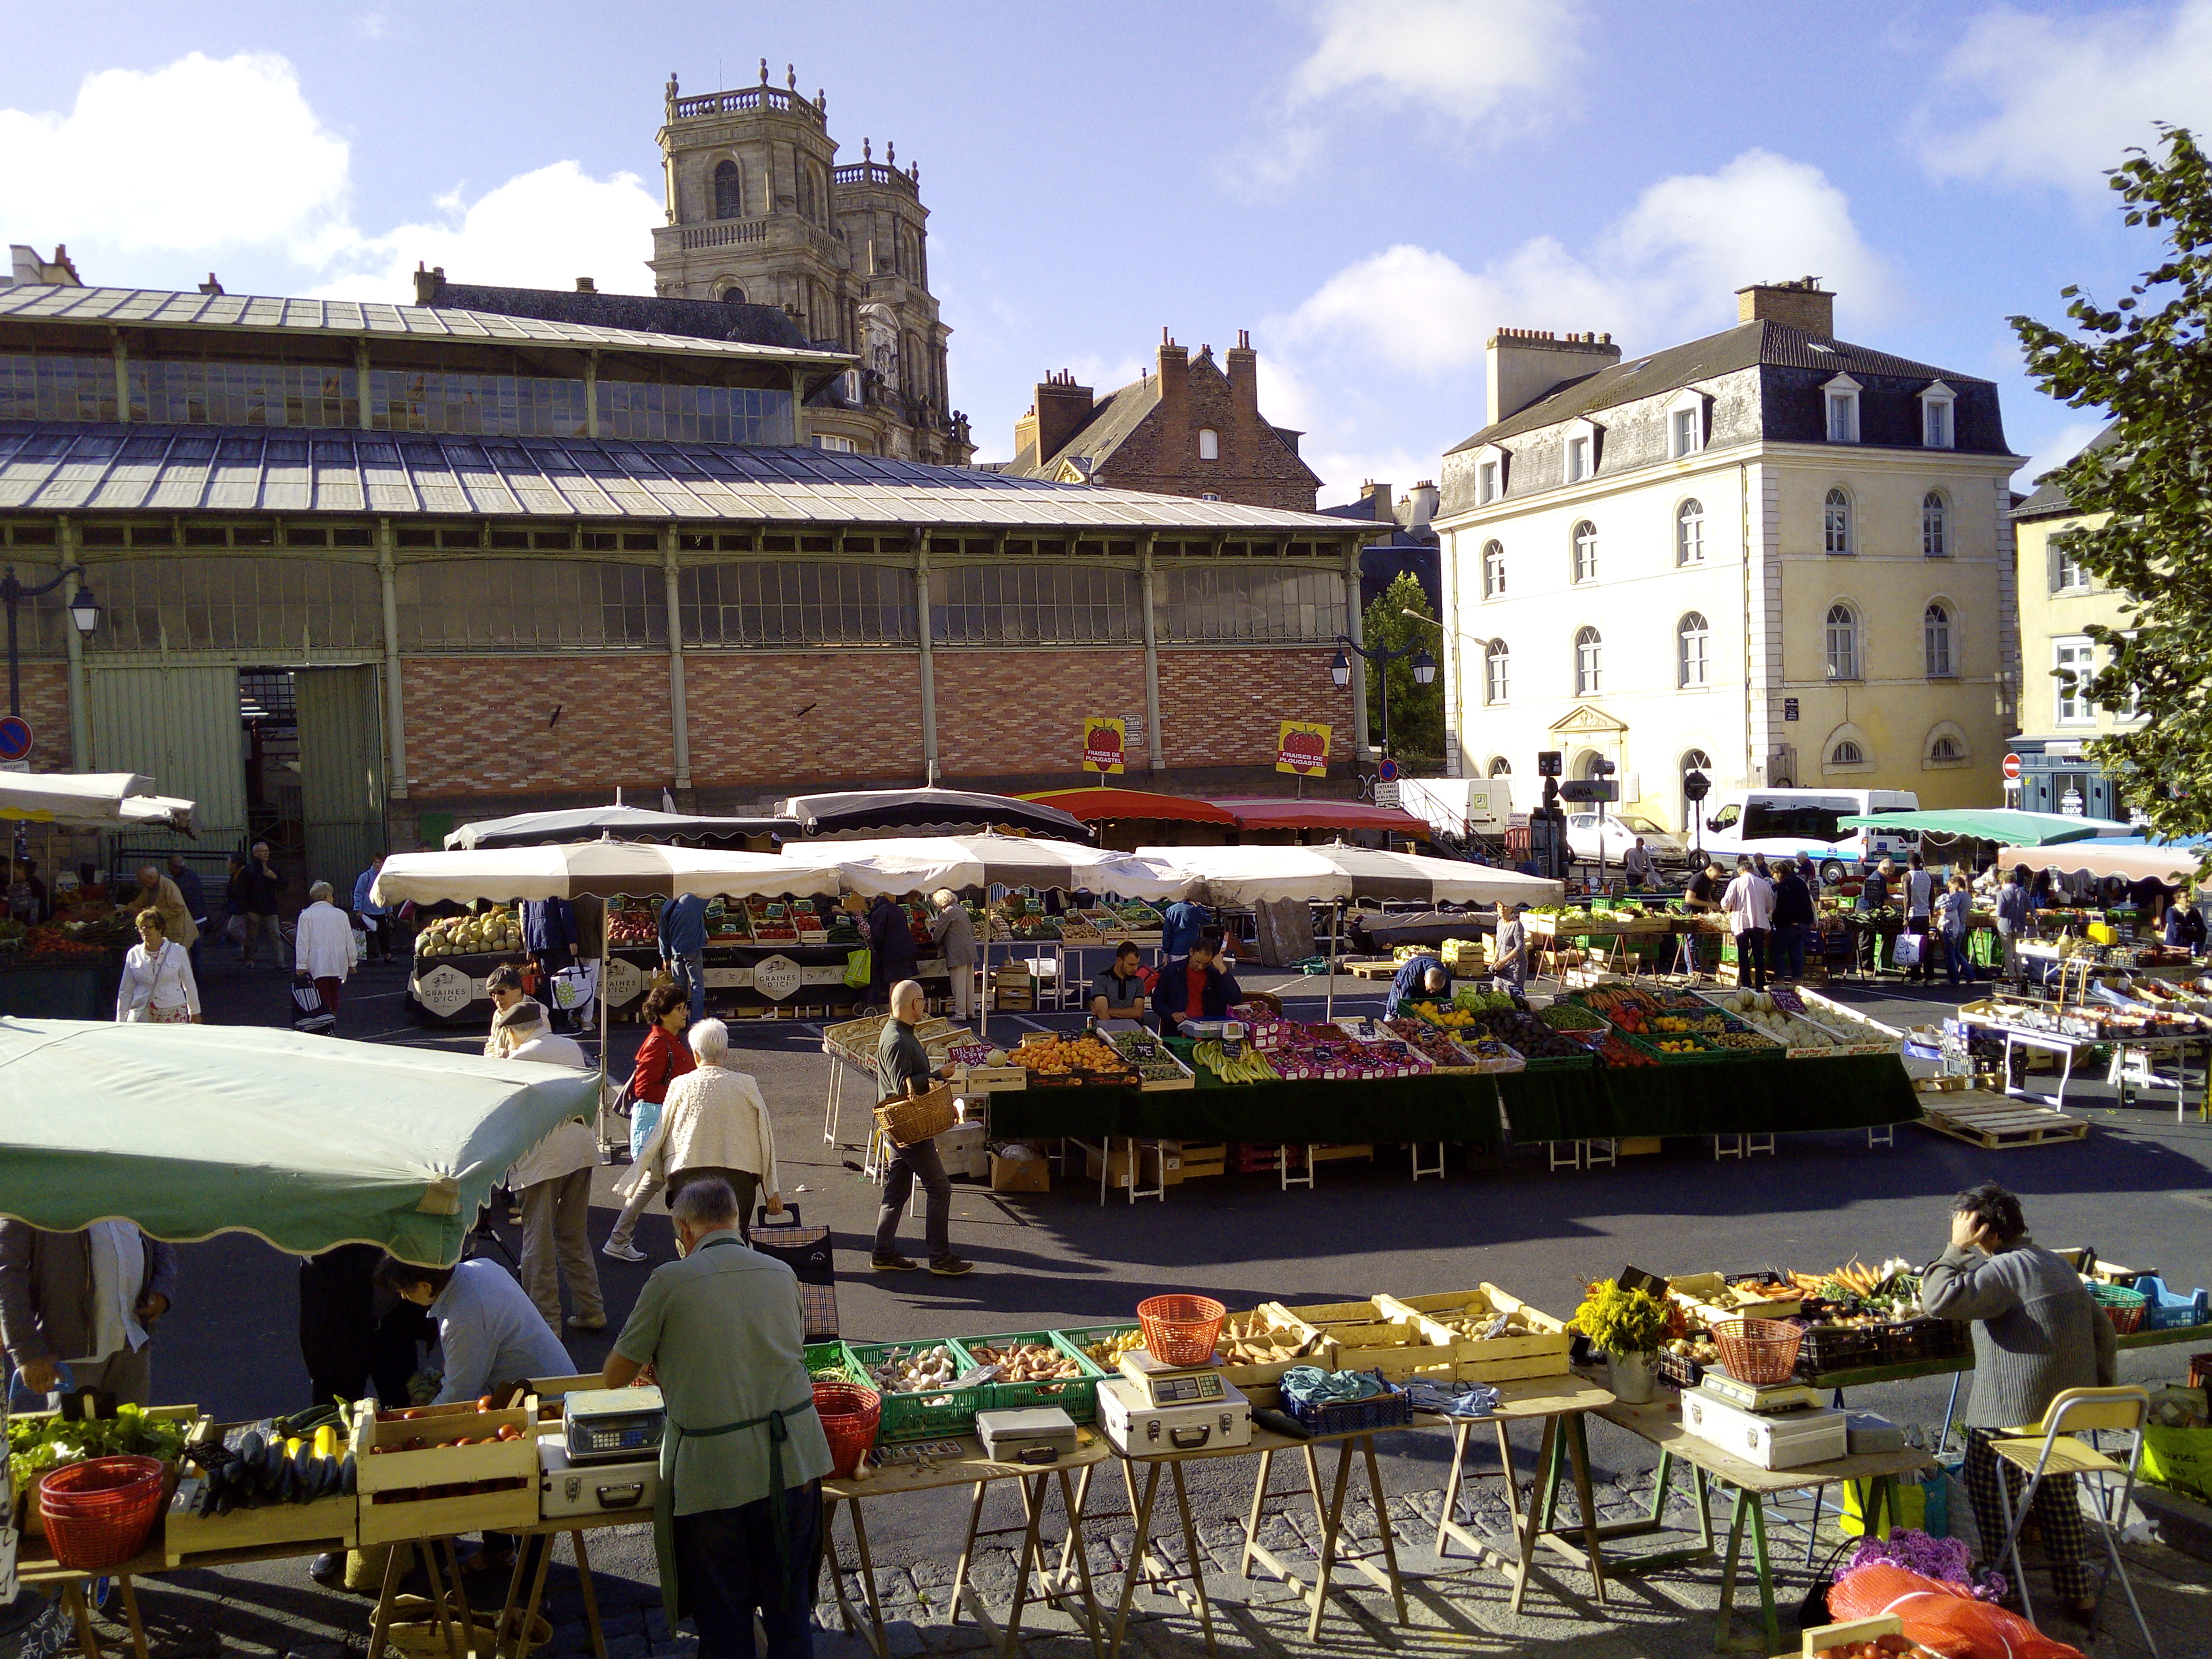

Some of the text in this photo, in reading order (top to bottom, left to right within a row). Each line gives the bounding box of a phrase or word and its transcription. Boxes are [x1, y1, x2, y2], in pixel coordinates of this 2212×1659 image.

[1085, 756, 1122, 764] PLOUGASTEL
[1282, 752, 1311, 760] FRAISES
[1279, 757, 1325, 767] PLOUGASTEL
[952, 1046, 983, 1056] MELON
